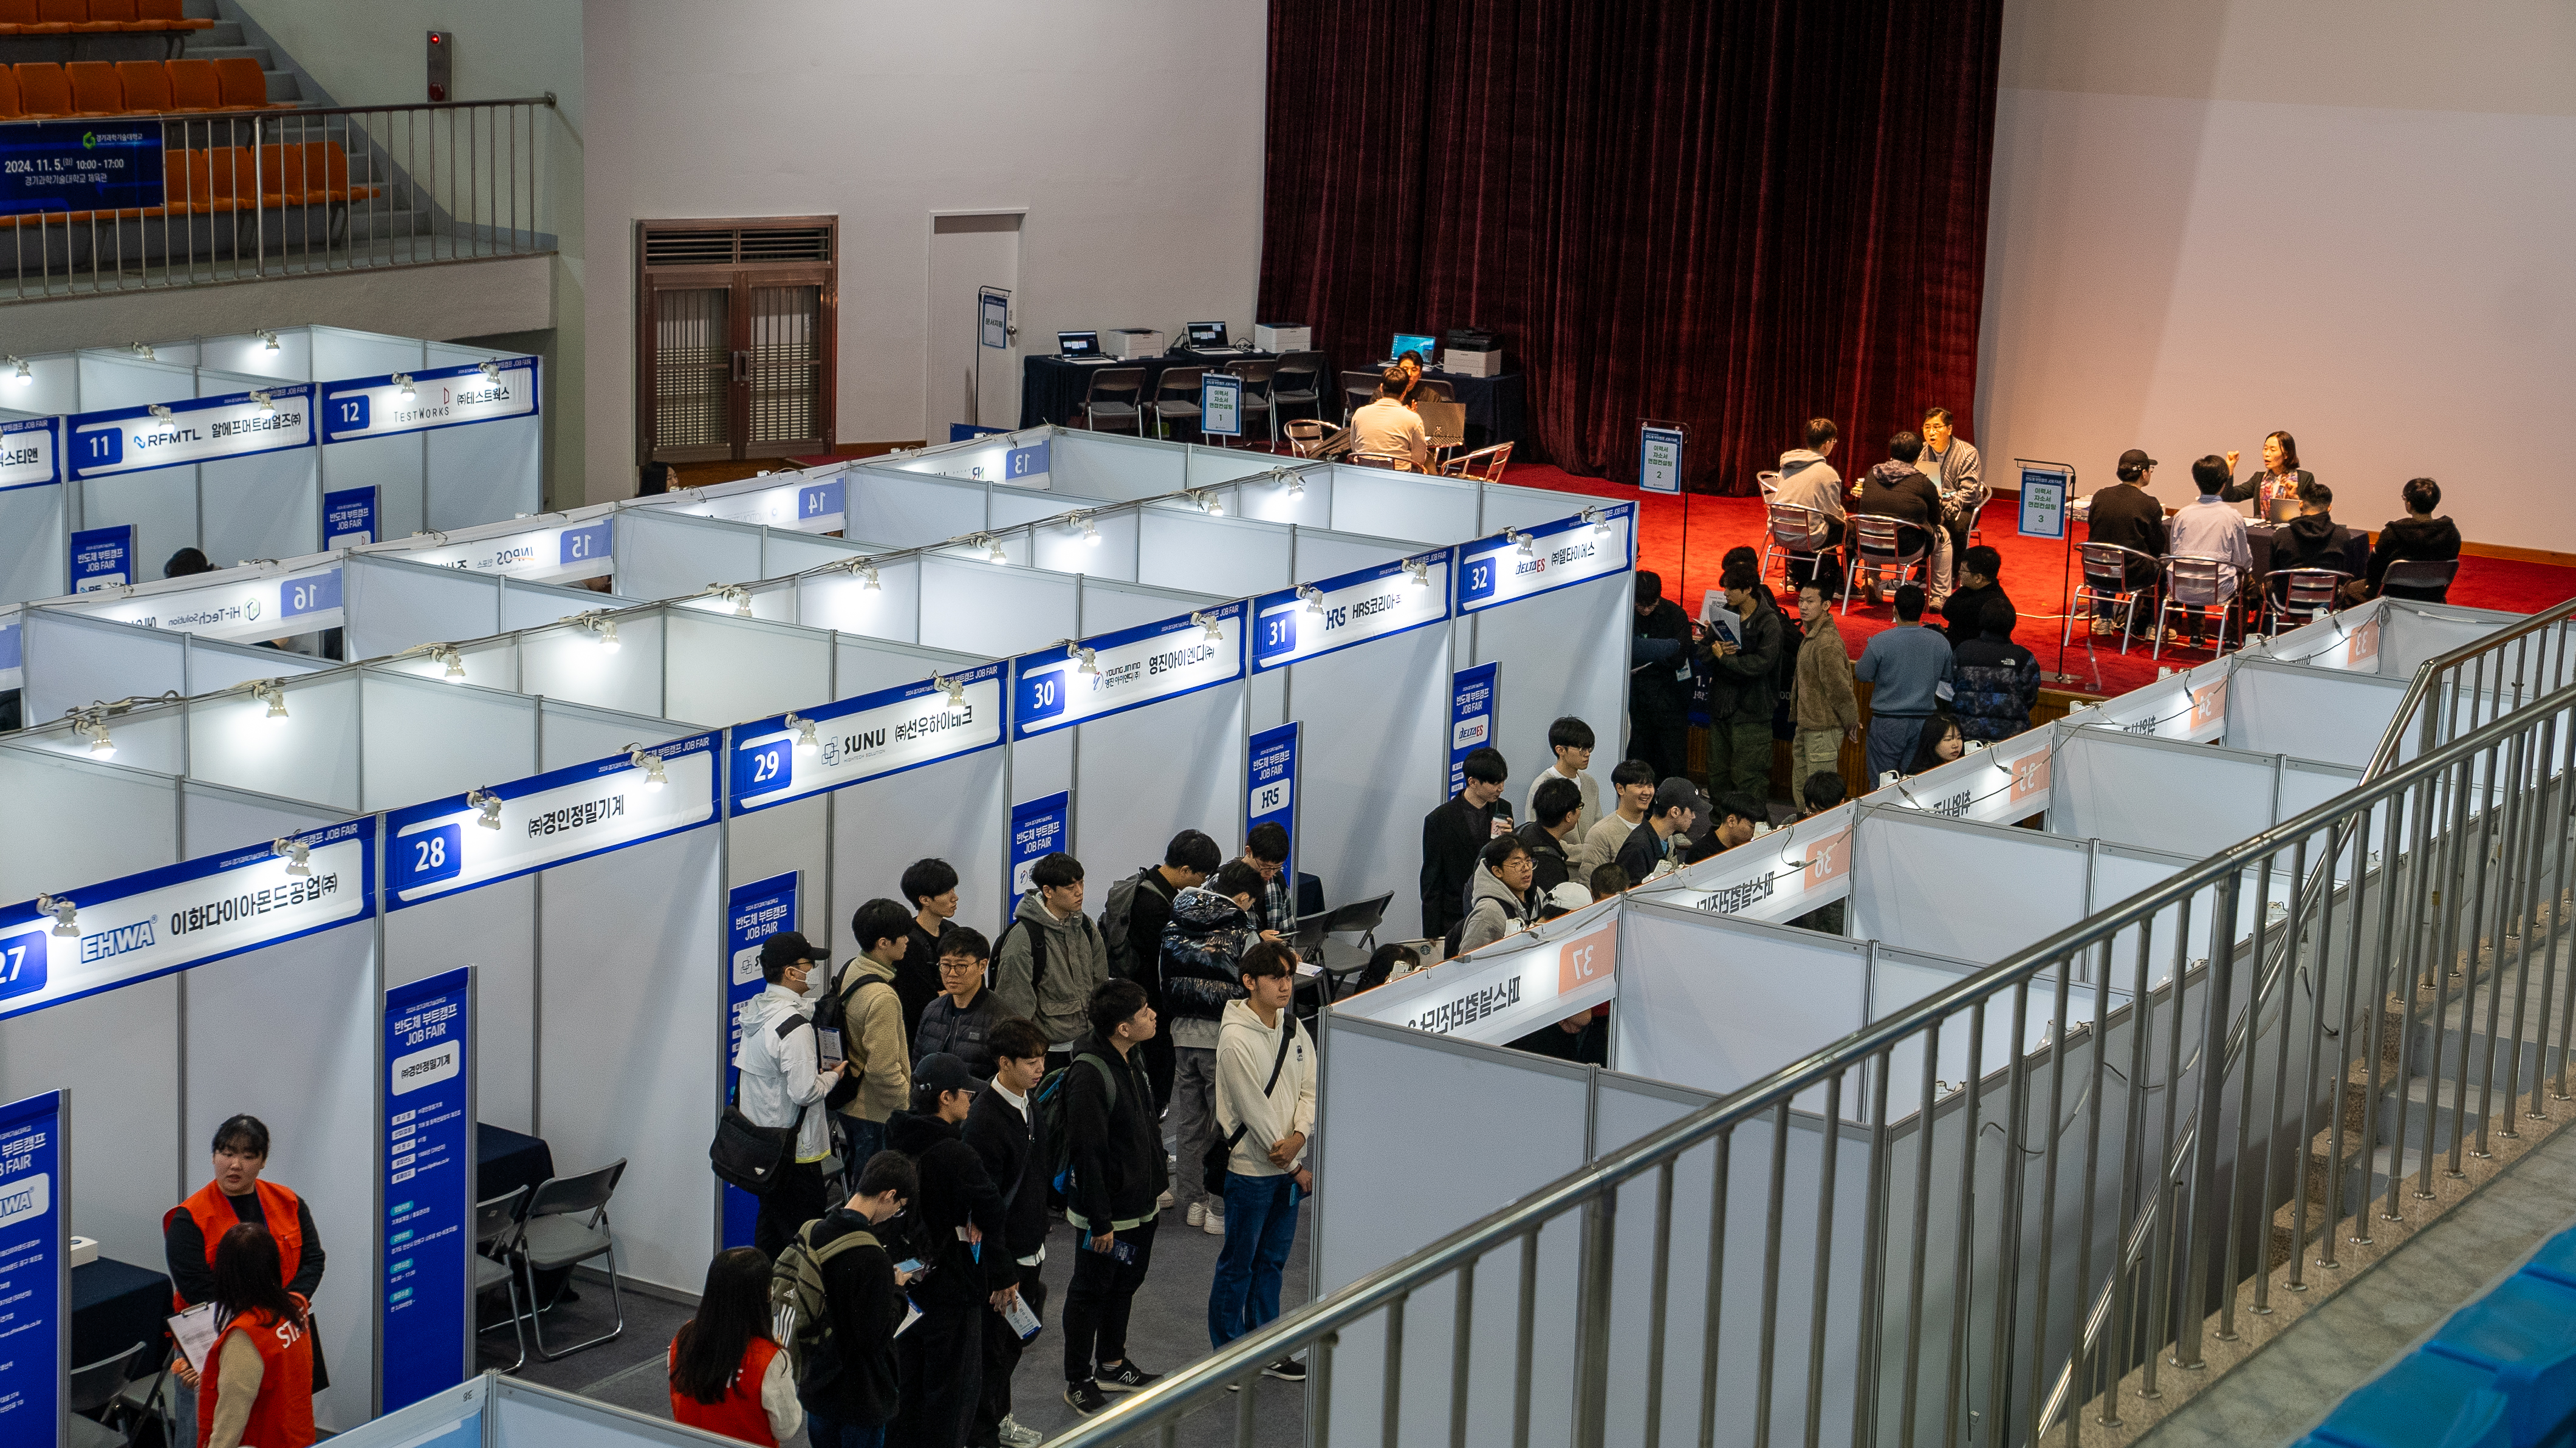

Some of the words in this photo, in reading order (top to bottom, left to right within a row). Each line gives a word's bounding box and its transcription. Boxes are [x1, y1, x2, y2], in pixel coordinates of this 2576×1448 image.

[5, 159, 33, 173] 2024.
[36, 159, 52, 171] 11.
[76, 160, 97, 169] 10:00
[104, 159, 124, 168] 17:00
[25, 174, 86, 186] 경기과학기술대학교
[88, 173, 108, 183] 체육관
[985, 318, 1003, 328] 문서지원
[341, 401, 360, 424] 12
[90, 435, 109, 457] 11
[337, 521, 349, 530] JOB
[349, 519, 362, 528] FAIR
[86, 562, 100, 572] JOB
[100, 559, 115, 570] FAIR
[1472, 565, 1488, 590] 32
[1220, 607, 1229, 617] JOB
[1229, 604, 1239, 615] FAIR
[1326, 606, 1346, 630] HRS
[1268, 620, 1286, 646] 31
[975, 669, 985, 679] JOB
[985, 665, 998, 676] FAIR
[1033, 680, 1055, 710] 30
[1461, 703, 1471, 715] JOB
[1471, 700, 1483, 712] FAIR
[682, 741, 694, 752] JOB
[696, 737, 710, 748] FAIR
[844, 728, 886, 756] SUNU
[753, 750, 779, 782] 29
[1253, 756, 1269, 772] 반도체
[1270, 750, 1290, 765] 부트캠프
[1259, 767, 1270, 780] JOB
[1271, 764, 1283, 777] FAIR
[1261, 787, 1279, 809] HRS
[324, 828, 340, 841] JOB
[341, 823, 358, 836] FAIR
[1016, 828, 1035, 844] 반도체
[1035, 821, 1060, 838] 부트캠프
[414, 836, 445, 873] 28
[1024, 841, 1036, 855] JOB
[1037, 836, 1052, 850] FAIR
[736, 912, 758, 931] 반도체
[759, 904, 787, 923] 부트캠프
[745, 926, 760, 941] JOB
[761, 921, 778, 937] FAIR
[394, 1014, 422, 1036] 반도체
[422, 1003, 457, 1026] 부트캠프
[405, 1028, 425, 1047] JOB
[425, 1022, 447, 1040] FAIR
[2, 1132, 46, 1158] 부트캠프
[5, 1153, 32, 1175] FAIR
